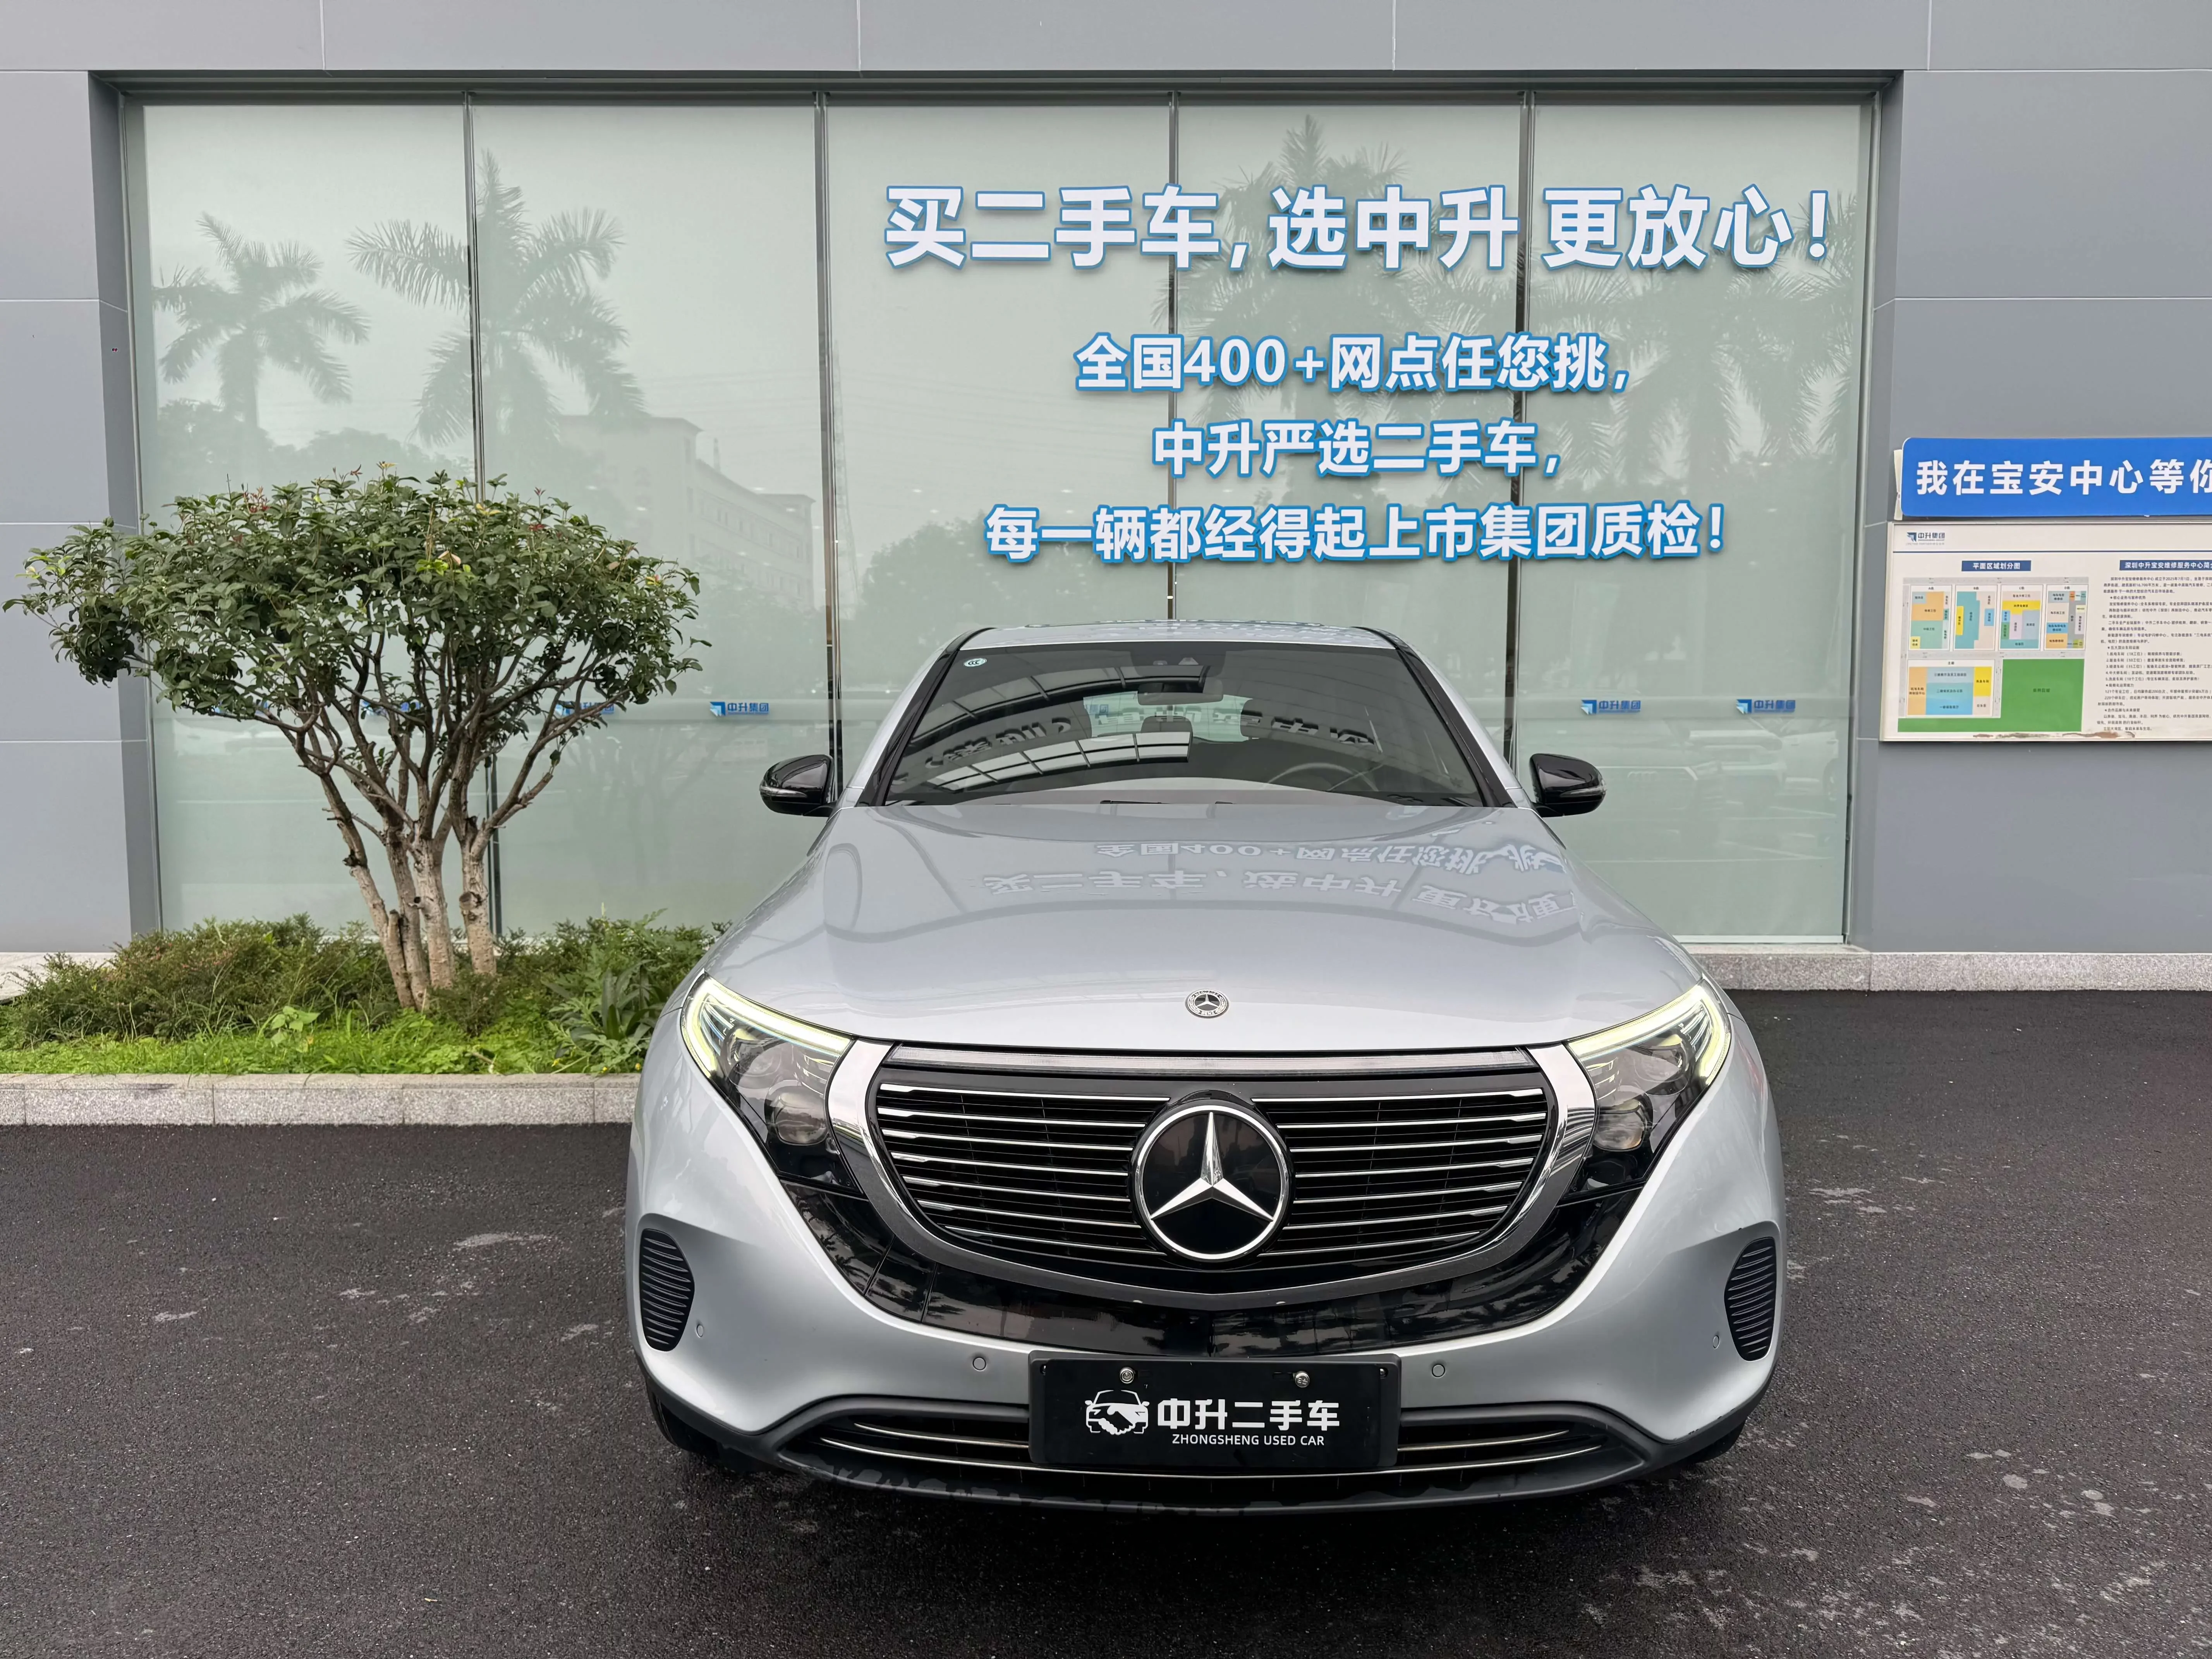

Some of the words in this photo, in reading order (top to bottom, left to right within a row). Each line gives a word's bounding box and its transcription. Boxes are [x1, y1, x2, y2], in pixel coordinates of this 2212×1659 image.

[1152, 417, 1561, 479] 中升严选二手车,
[984, 500, 1724, 563] 每一辆都经得起上市集团质检!
[728, 702, 769, 712] 中升集团
[1599, 700, 1641, 710] 中升集团
[1754, 700, 1796, 710] 中升集团
[1158, 1398, 1340, 1431] 中升二手车
[1172, 1434, 1259, 1445] ZHONGSHENG
[1264, 1435, 1296, 1445] USED
[1300, 1436, 1324, 1446] CAR
